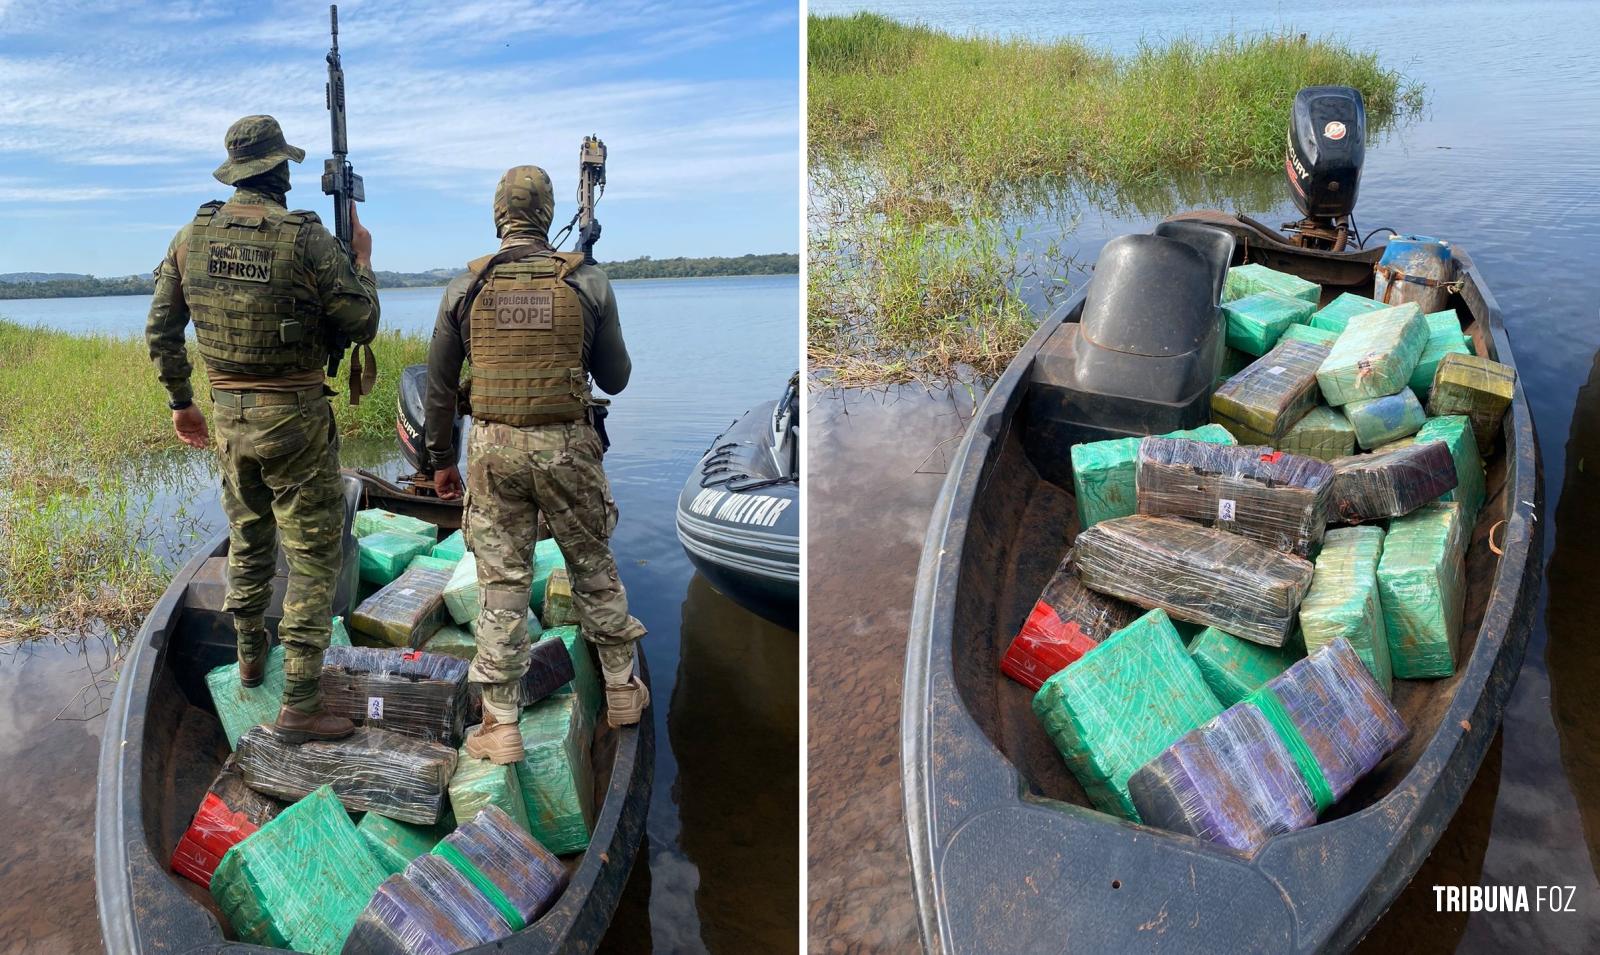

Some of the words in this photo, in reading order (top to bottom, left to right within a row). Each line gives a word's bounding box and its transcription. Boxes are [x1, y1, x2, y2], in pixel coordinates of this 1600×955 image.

[240, 248, 270, 264] MILITAR
[209, 259, 269, 280] BPFRON
[498, 294, 529, 306] POLÍCIA
[530, 295, 551, 306] CIVIL
[497, 307, 551, 325] COPE
[715, 492, 792, 527] MILITAR
